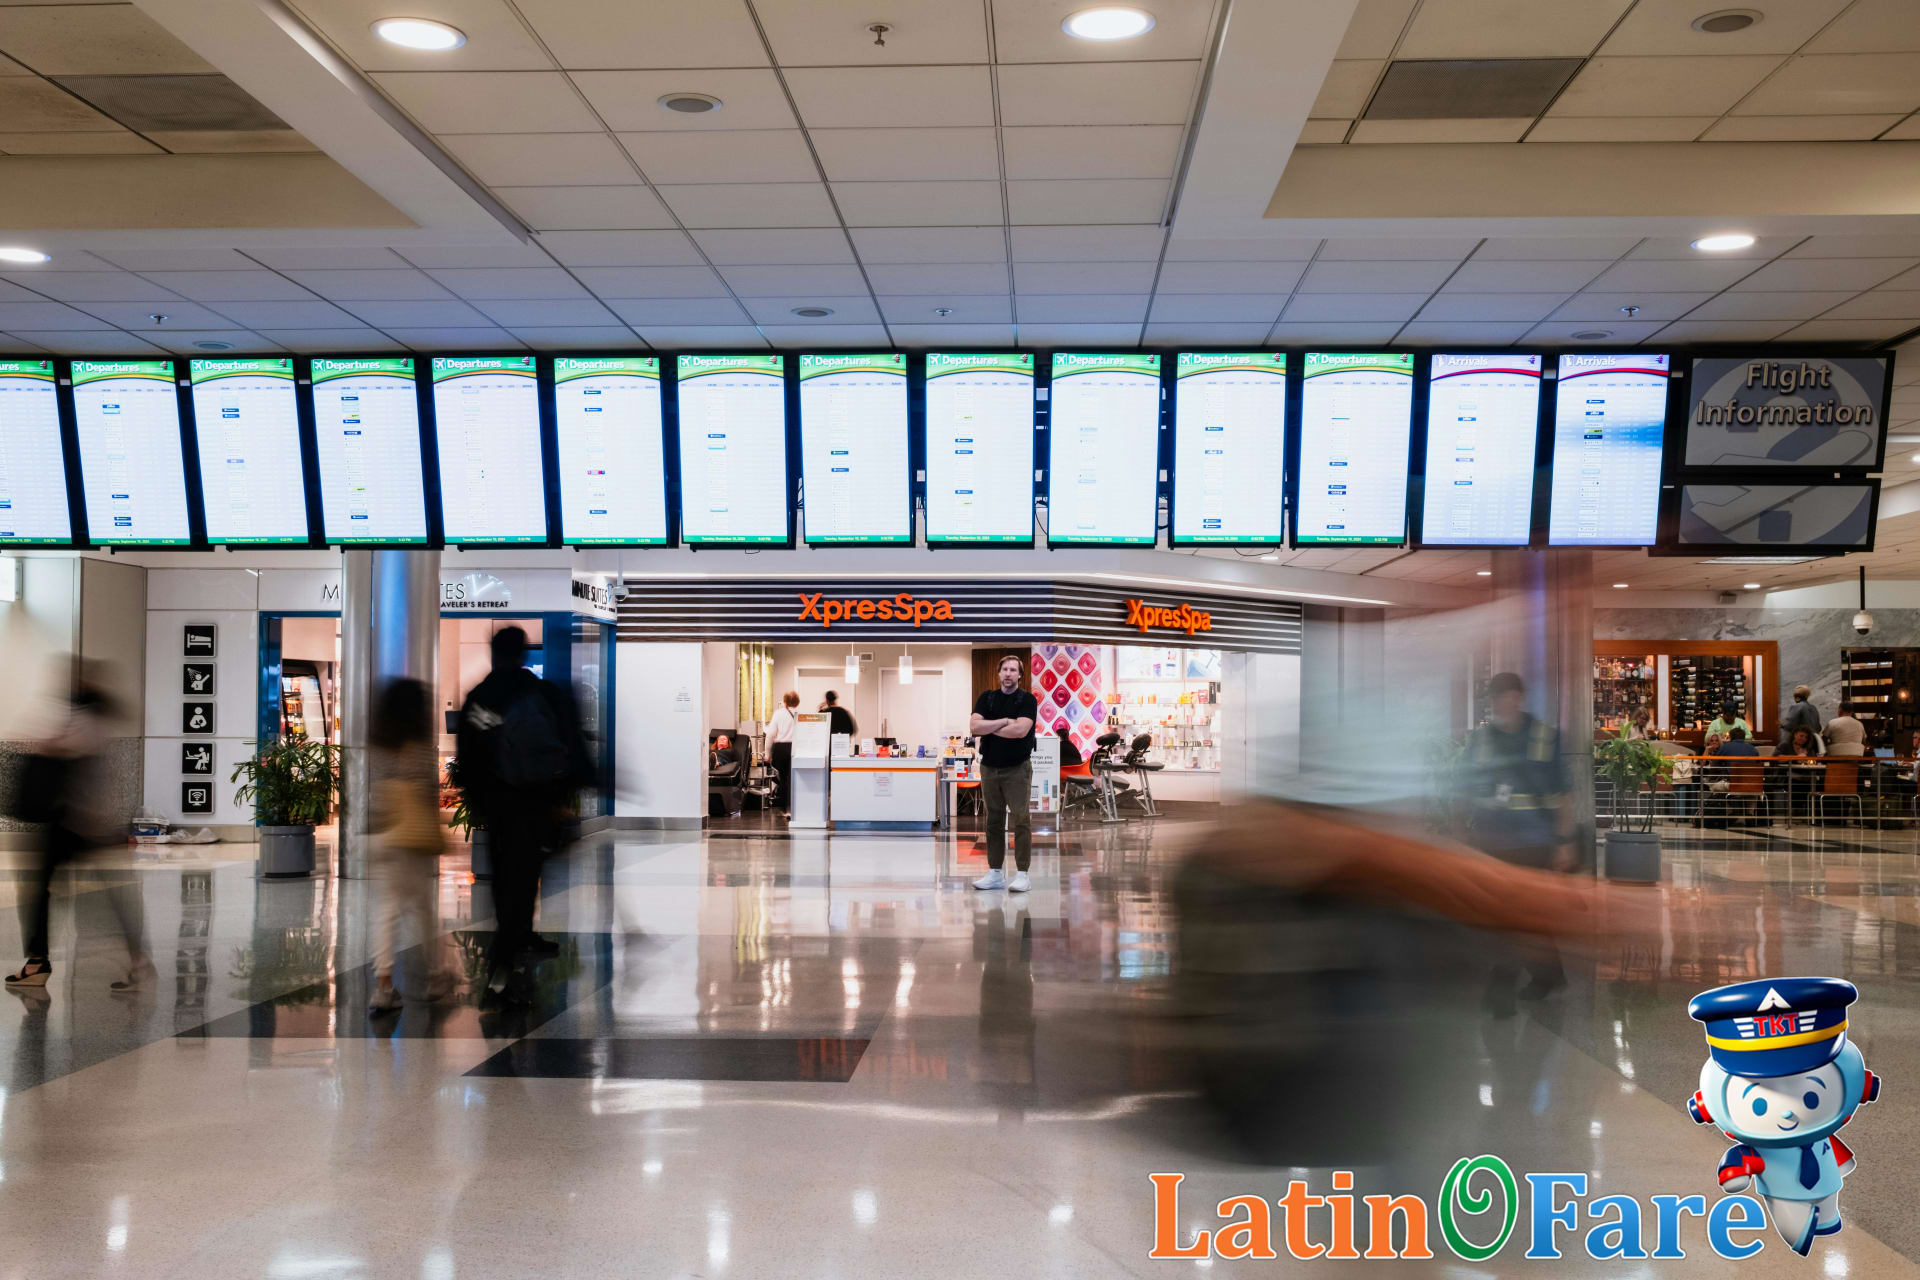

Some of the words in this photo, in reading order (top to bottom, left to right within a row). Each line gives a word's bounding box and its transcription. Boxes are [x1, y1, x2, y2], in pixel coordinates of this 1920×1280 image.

[446, 359, 502, 370] Departures
[570, 359, 625, 370] Departures
[693, 357, 748, 368] Departures
[815, 356, 871, 367] Departures
[942, 355, 998, 366] Departures
[1068, 355, 1125, 366] Departures
[1193, 354, 1250, 366] Departures
[1321, 354, 1378, 365] Departures
[1447, 356, 1489, 366] Arrivals
[1575, 356, 1616, 366] Arrivals
[86, 362, 140, 372] Departures
[204, 361, 259, 371] Departures
[326, 360, 380, 371] Departures
[1746, 361, 1832, 394] Flight
[1696, 399, 1873, 425] Information
[798, 592, 954, 628] XpresSpa
[1125, 599, 1212, 635] XpresSpa
